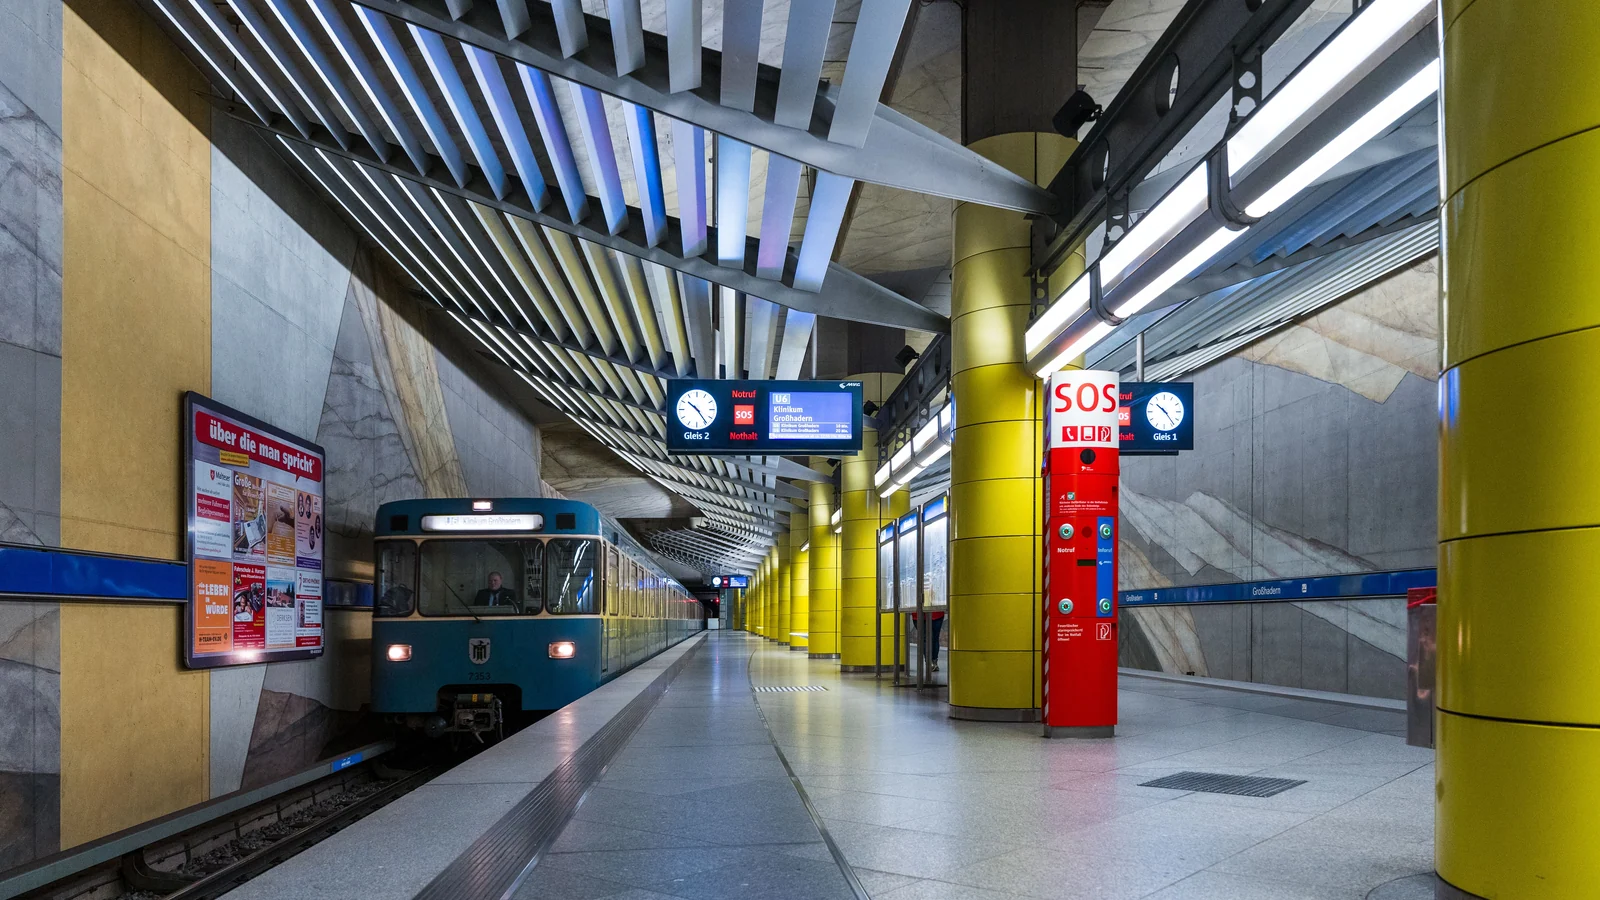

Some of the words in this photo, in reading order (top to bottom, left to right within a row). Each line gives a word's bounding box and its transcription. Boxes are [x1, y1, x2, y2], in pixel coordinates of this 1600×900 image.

[732, 389, 757, 398] Notruf
[1054, 382, 1117, 413] SOS
[1118, 392, 1133, 400] truf
[775, 394, 788, 403] U6
[735, 410, 752, 419] SOS
[773, 414, 813, 422] Großhadern
[683, 431, 703, 440] Gleis
[704, 432, 710, 440] 2
[729, 432, 758, 441] Nothalt
[1118, 432, 1135, 441] thalt
[1153, 432, 1172, 441] Gleis
[1173, 433, 1178, 441] 1
[209, 419, 236, 446] über
[239, 433, 256, 454] die
[259, 443, 280, 462] man
[234, 474, 252, 489] Große
[488, 516, 521, 525] Großhadern
[205, 583, 229, 597] LEBEN
[1252, 586, 1281, 596] Großhadern
[1125, 594, 1143, 603] Großhadern
[205, 601, 229, 615] WÜRDE
[467, 672, 491, 681] 7353
